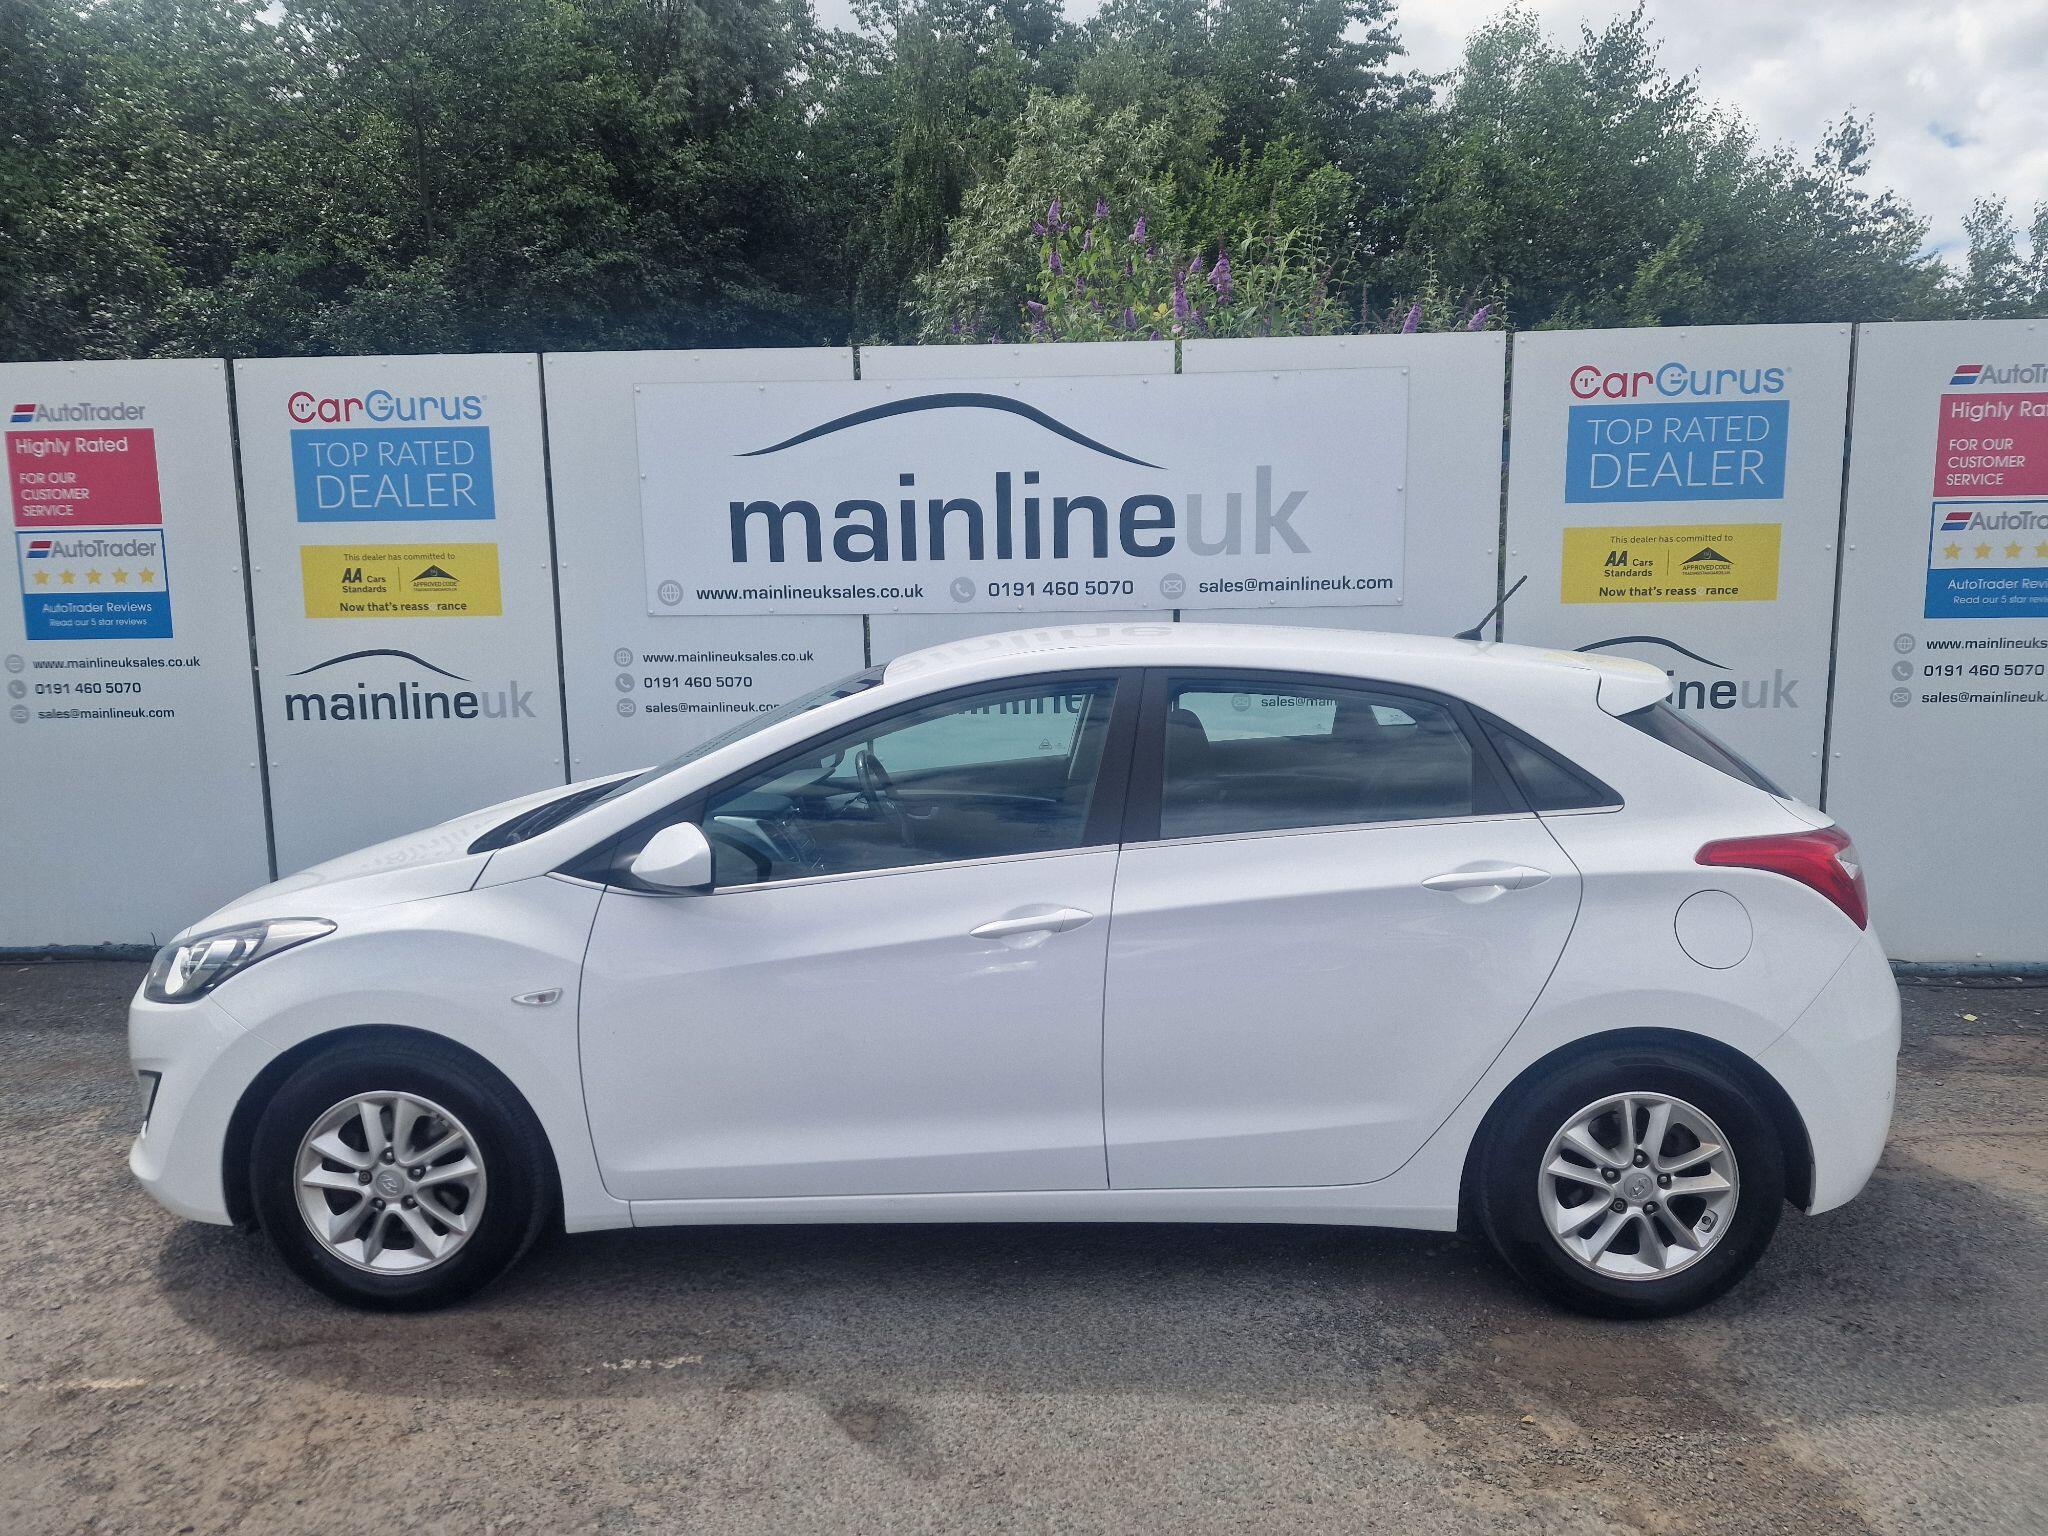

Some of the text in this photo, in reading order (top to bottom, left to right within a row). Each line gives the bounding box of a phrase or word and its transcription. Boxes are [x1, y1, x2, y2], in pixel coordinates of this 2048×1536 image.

[1570, 362, 1786, 399] CarGurus
[36, 402, 146, 423] AutoTrader
[288, 389, 483, 424] CarGurus
[1951, 401, 2015, 422] Highly
[1587, 415, 1770, 446] TOP RATED
[15, 436, 129, 458] Highly Rated
[1949, 438, 2014, 451] FOR OUR
[308, 440, 475, 467] TOP RATED
[1948, 455, 2026, 468] CUSTOMER
[1590, 449, 1766, 489] DEALER
[19, 472, 77, 484] FOR OUR
[1946, 473, 2004, 486] SERVICE
[21, 488, 90, 500] CUSTOMER
[316, 473, 477, 509] DEALER
[22, 504, 74, 517] SERVICE
[729, 464, 1311, 563] mainlineuk
[1610, 536, 1628, 544] This
[1630, 535, 1656, 544] dealer
[1659, 535, 1674, 543] has
[1676, 534, 1723, 543] committed
[51, 539, 157, 558] AutoTrader
[344, 552, 456, 561] This dealer has committed to
[1604, 550, 1654, 567] AA Cars
[341, 567, 387, 584] AA Cars
[1604, 568, 1653, 577] Standards
[342, 585, 387, 593] Standards
[988, 580, 1134, 597] 0191 460 5070
[1199, 575, 1393, 594] sales@mainlineuk.com
[1948, 578, 2018, 590] AutoTrader
[696, 584, 924, 601] www.mainlineuksales.co.uk
[1599, 587, 1626, 597] Now
[1629, 586, 1662, 596] that's
[1953, 595, 1980, 604] Read
[2009, 595, 2028, 604] star
[42, 602, 152, 613] AutoTrader Reviews
[340, 602, 365, 612] Now
[367, 602, 398, 611] that's
[75, 619, 89, 627] our
[98, 617, 114, 626] star
[115, 617, 148, 626] reviews
[33, 655, 201, 669] www.mainlineuksales.co.uk
[642, 650, 814, 663] www.mainlineuksales.co.uk
[1923, 664, 2045, 677] 0191 460 5070
[34, 682, 142, 695] 0191 460 5070
[644, 676, 753, 688] 0191 460 5070
[284, 680, 537, 722] mainlineuk
[38, 708, 175, 720] sales@mainlineuk.com
